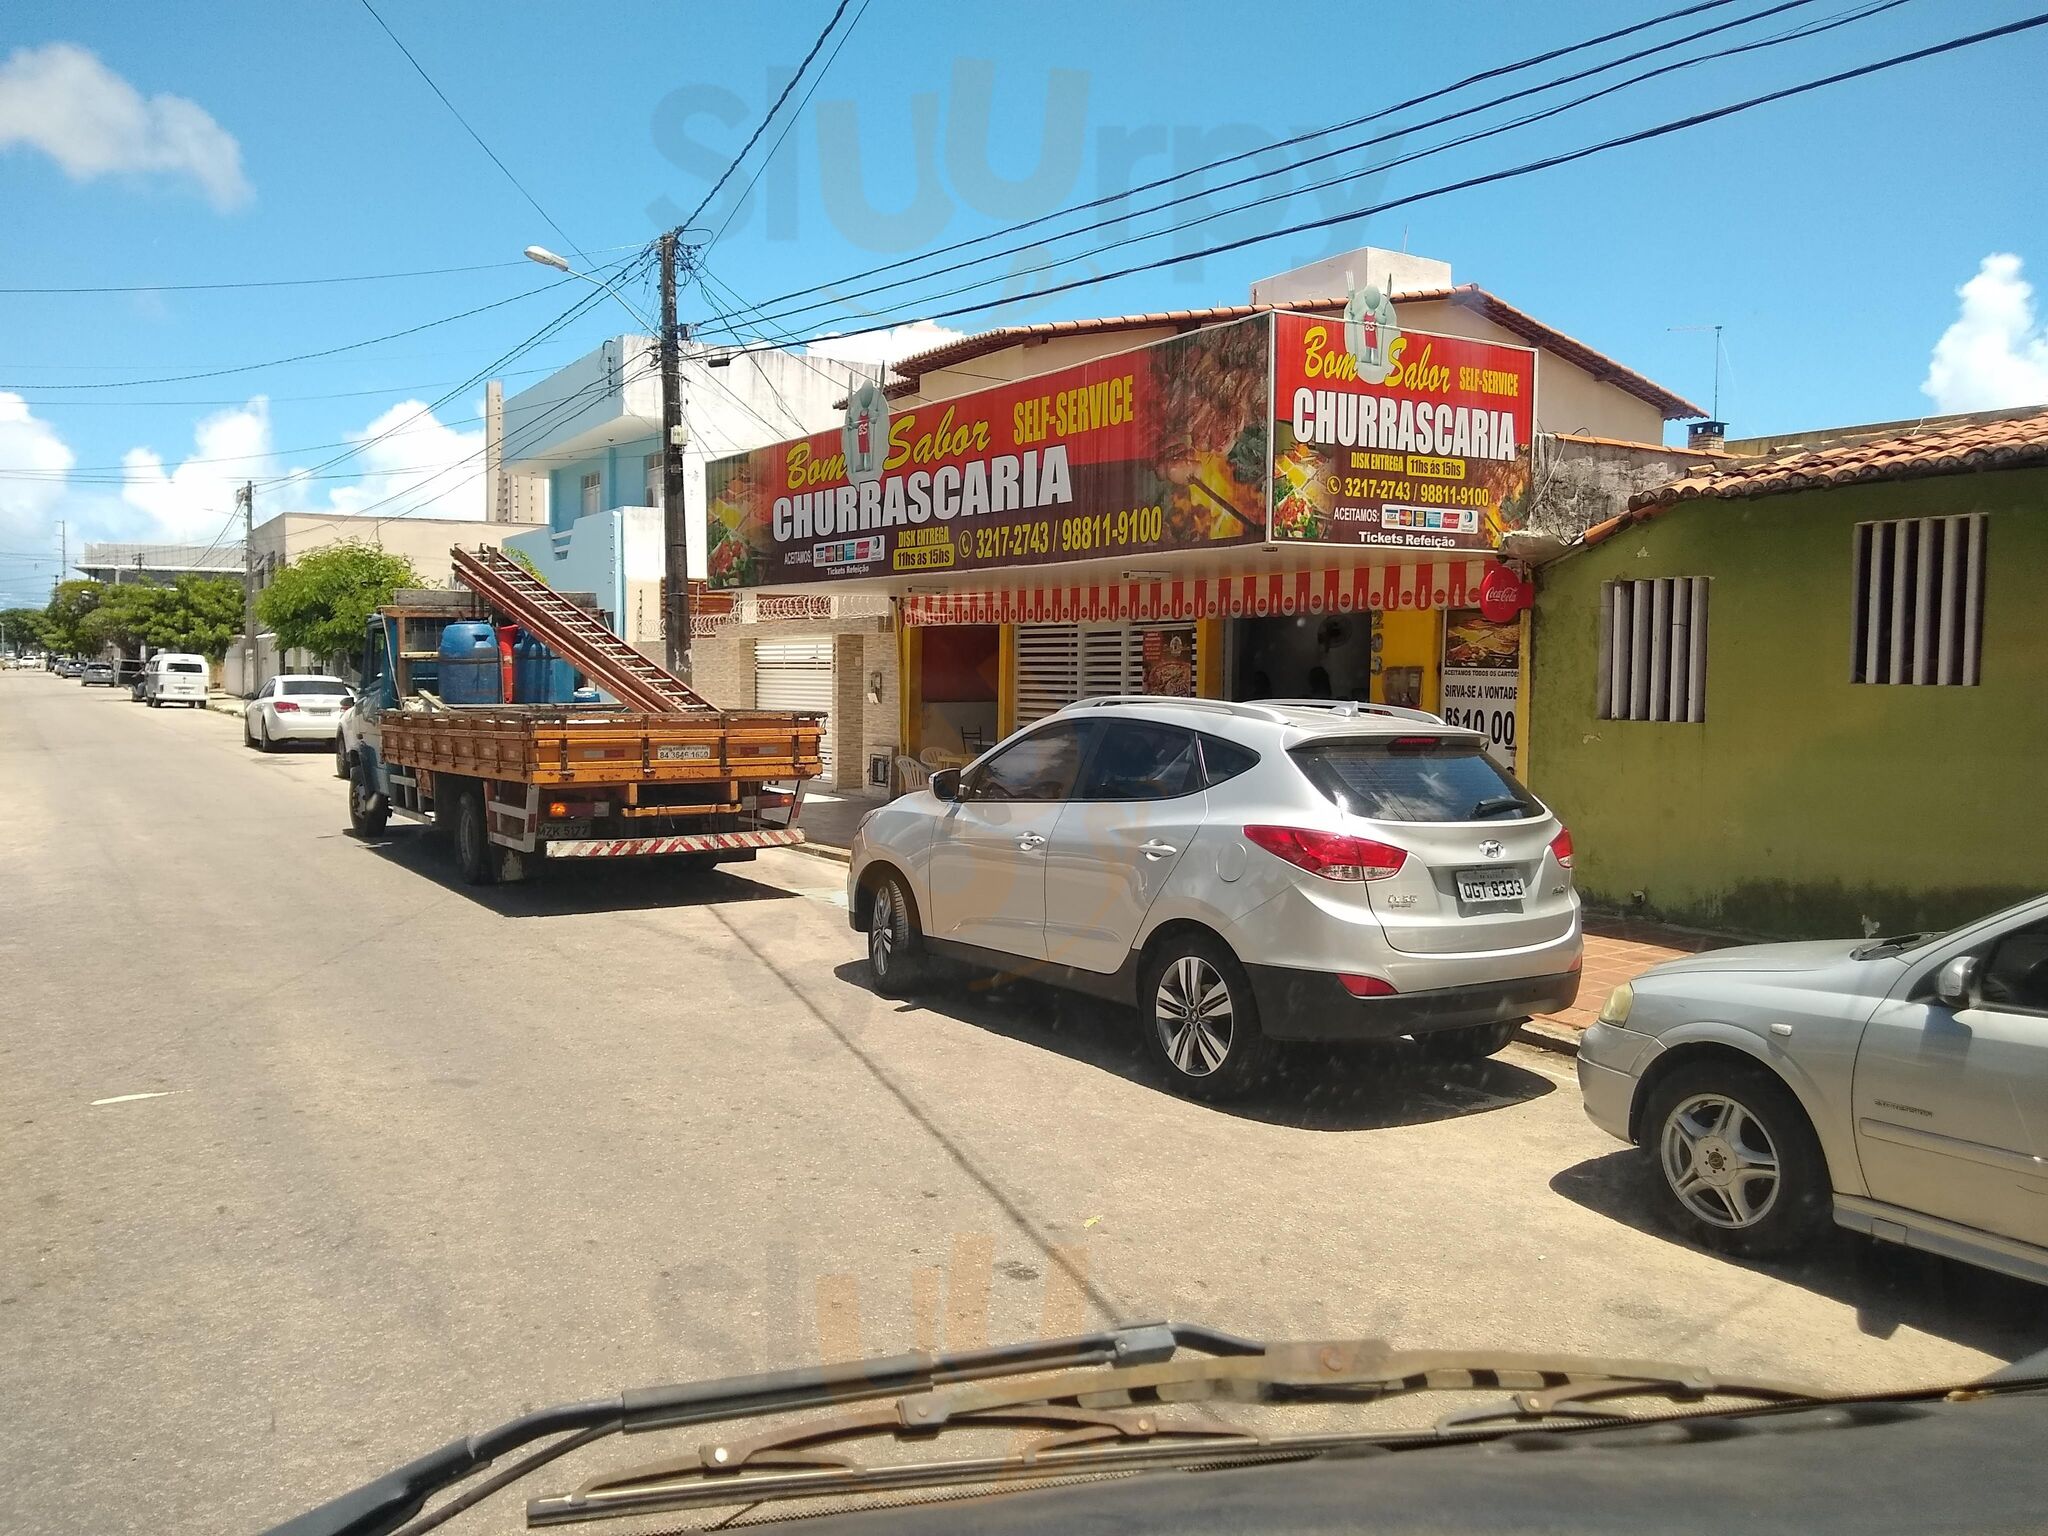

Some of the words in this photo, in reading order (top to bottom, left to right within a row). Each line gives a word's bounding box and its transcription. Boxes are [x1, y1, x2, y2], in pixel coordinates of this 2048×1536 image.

[1303, 325, 1358, 382] Bom
[1384, 336, 1450, 394] Sabor
[1459, 366, 1519, 397] SELF-SERVICE
[786, 441, 847, 490] Bom
[882, 404, 991, 471] Sabor
[1013, 375, 1134, 446] SELF-SERVICE
[1293, 387, 1516, 462] CHURRASCARIA
[1351, 452, 1370, 469] DISK
[1371, 454, 1404, 472] ENTREGA
[1410, 459, 1429, 474] 11hs
[1442, 462, 1461, 476] 15hs
[772, 444, 1073, 542] CHURRASCARIA
[1344, 477, 1411, 501] 3217-2743
[1420, 484, 1489, 507] 98811-9100
[1333, 506, 1380, 523] ACEITAMOS:
[898, 530, 916, 548] DISK
[916, 525, 949, 546] ENTREGA
[976, 521, 1049, 559] 3217-2743
[1062, 505, 1162, 552] 98811-9100
[1358, 531, 1403, 544] Tickets
[1405, 534, 1456, 548] Refeição
[897, 551, 916, 567] 11hs
[928, 548, 950, 565] 15hs
[826, 566, 846, 576] Tickets
[1444, 669, 1471, 677] ACEITAMOS
[1444, 685, 1476, 698] SIRVA-SE
[1477, 686, 1482, 699] A
[1484, 686, 1518, 700] VONTADE
[1445, 707, 1460, 727] R$
[1491, 880, 1523, 897] 8333
